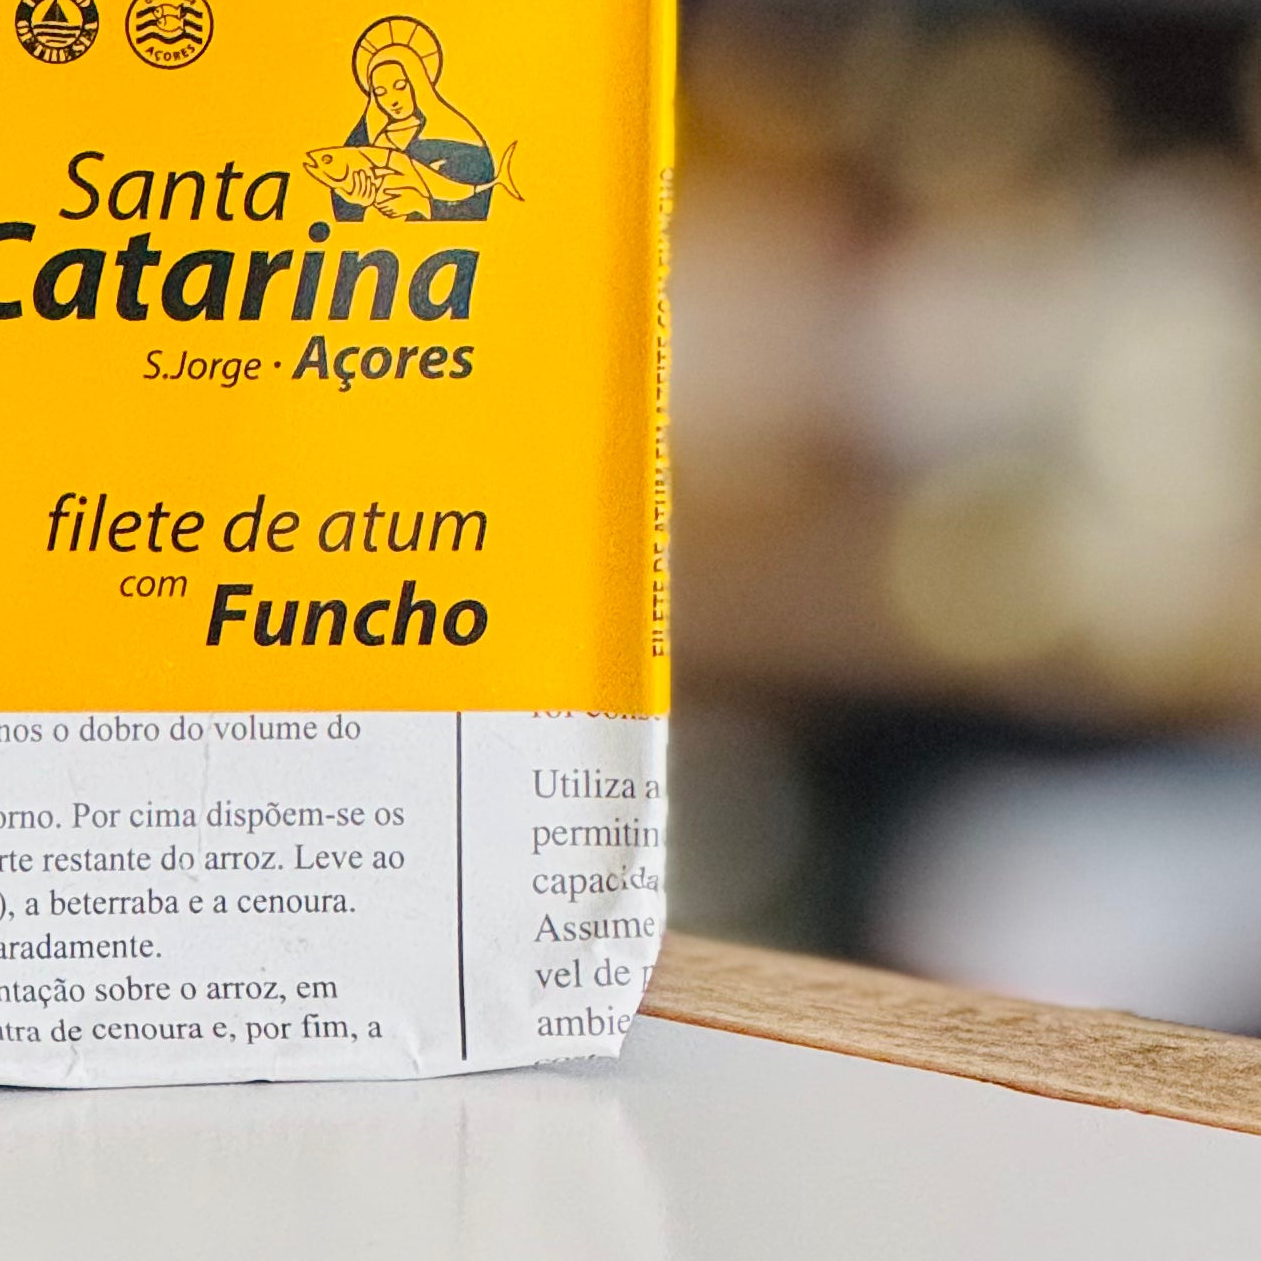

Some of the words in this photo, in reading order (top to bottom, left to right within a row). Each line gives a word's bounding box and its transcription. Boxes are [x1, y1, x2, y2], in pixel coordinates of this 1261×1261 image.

[34, 40, 71, 64] THE
[145, 44, 196, 63] AÇORES
[58, 150, 291, 222] Santa
[142, 349, 262, 389] S.Jorge
[290, 334, 475, 394] Açores
[46, 491, 206, 554] filete
[222, 493, 301, 554] de
[317, 501, 488, 554] atum
[119, 574, 188, 598] com
[205, 579, 489, 648] Funcho
[52, 722, 70, 743] o
[78, 714, 160, 743] dobro
[169, 714, 205, 742] do
[213, 713, 318, 742] volume
[326, 713, 362, 741] do
[532, 768, 637, 800] Utiliza
[644, 780, 661, 802] a
[71, 802, 122, 829] Por
[129, 800, 198, 829] cima
[205, 799, 366, 835] dispõem-se
[374, 806, 405, 827] os
[531, 817, 659, 856] permitin
[41, 847, 152, 873] restante
[160, 843, 195, 872] do
[204, 850, 284, 872] arroz.
[293, 843, 364, 870] Leve
[371, 850, 405, 870] ao
[532, 864, 660, 904] capacida
[24, 897, 41, 917] a
[48, 887, 180, 917] beterraba
[188, 894, 204, 915] e
[212, 894, 229, 915] a
[236, 893, 356, 914] cenoura.
[533, 913, 655, 943] Assume
[94, 974, 171, 1003] sobre
[179, 981, 197, 1001] o
[206, 981, 287, 1005] arroz,
[296, 980, 339, 1000] em
[534, 957, 583, 990] vel
[593, 957, 631, 988] de
[50, 1018, 83, 1043] de
[91, 1022, 205, 1041] cenoura
[211, 1021, 237, 1043] e,
[244, 1021, 293, 1046] por
[300, 1012, 358, 1044] fim,
[367, 1020, 384, 1039] a
[536, 1004, 632, 1037] ambie
